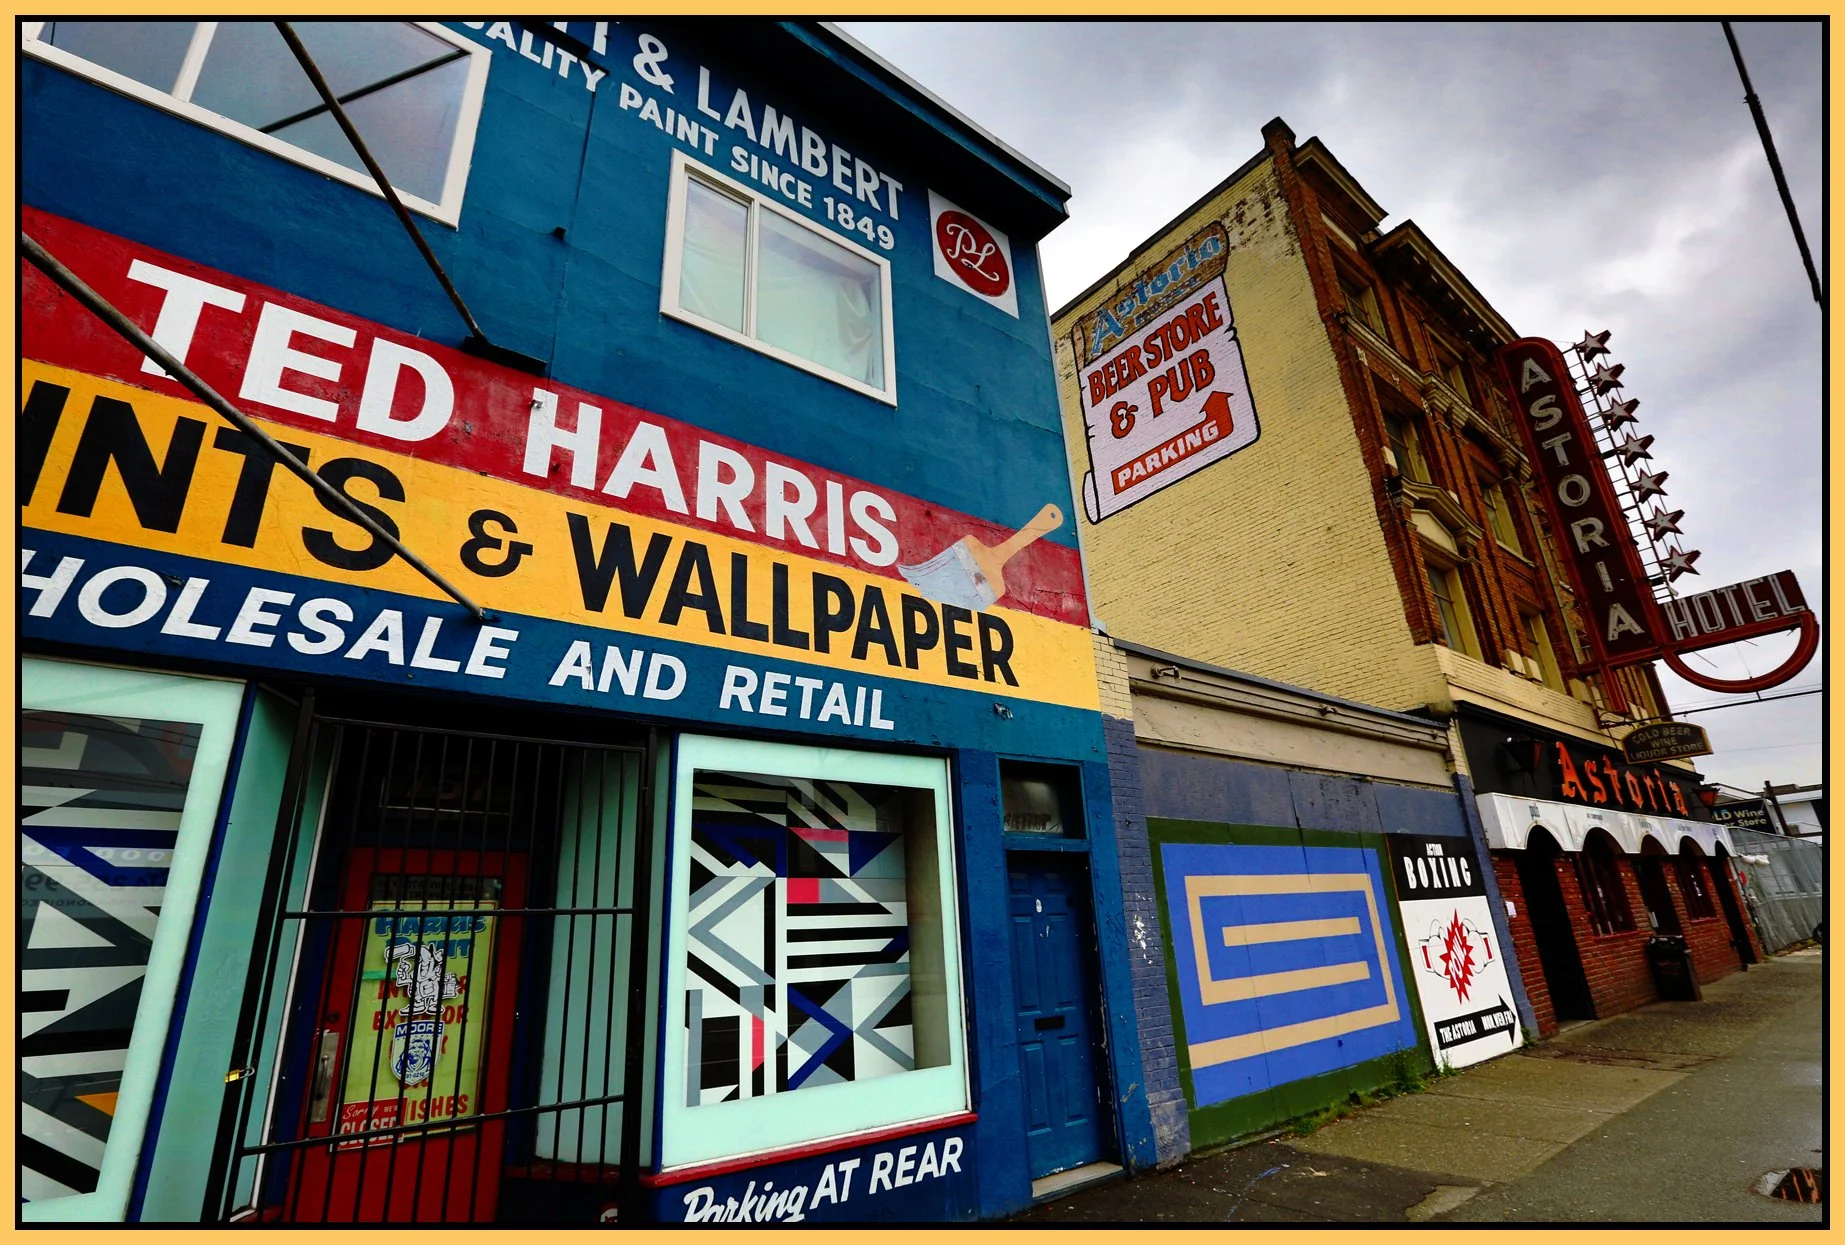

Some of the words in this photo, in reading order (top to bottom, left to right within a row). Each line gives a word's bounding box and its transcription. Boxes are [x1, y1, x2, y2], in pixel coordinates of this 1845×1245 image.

[462, 22, 606, 92] ALITY
[619, 82, 719, 157] PAINT
[731, 145, 814, 210] SINCE
[823, 195, 895, 251] 1849
[698, 66, 903, 221] LAMBERT
[1087, 344, 1149, 408] BEER
[1142, 290, 1225, 369] STORE
[127, 258, 455, 442] TED
[523, 386, 899, 568] HARRIS
[1109, 400, 1139, 439] &
[1147, 348, 1217, 419] PUB
[1116, 419, 1219, 488] PARKING
[1520, 357, 1645, 642] ASTORIA
[459, 508, 534, 577] &
[566, 511, 1020, 688] WALLPAPER
[1664, 573, 1809, 641] HOTEL
[548, 640, 688, 701] AND
[719, 665, 896, 731] RETAIL
[1632, 728, 1660, 745] COLD
[1662, 726, 1691, 739] BEER
[1651, 737, 1678, 748] WINE
[1671, 742, 1704, 754] STORE
[1556, 741, 1688, 817] Astoria
[1712, 809, 1732, 821] LD
[1733, 809, 1765, 818] Wine
[1737, 818, 1767, 827] Store
[1403, 856, 1472, 890] BOXING
[1452, 1019, 1477, 1040] ASTORIA
[683, 1181, 809, 1222] Parking
[809, 1158, 861, 1210] AT
[868, 1136, 965, 1195] REAR
